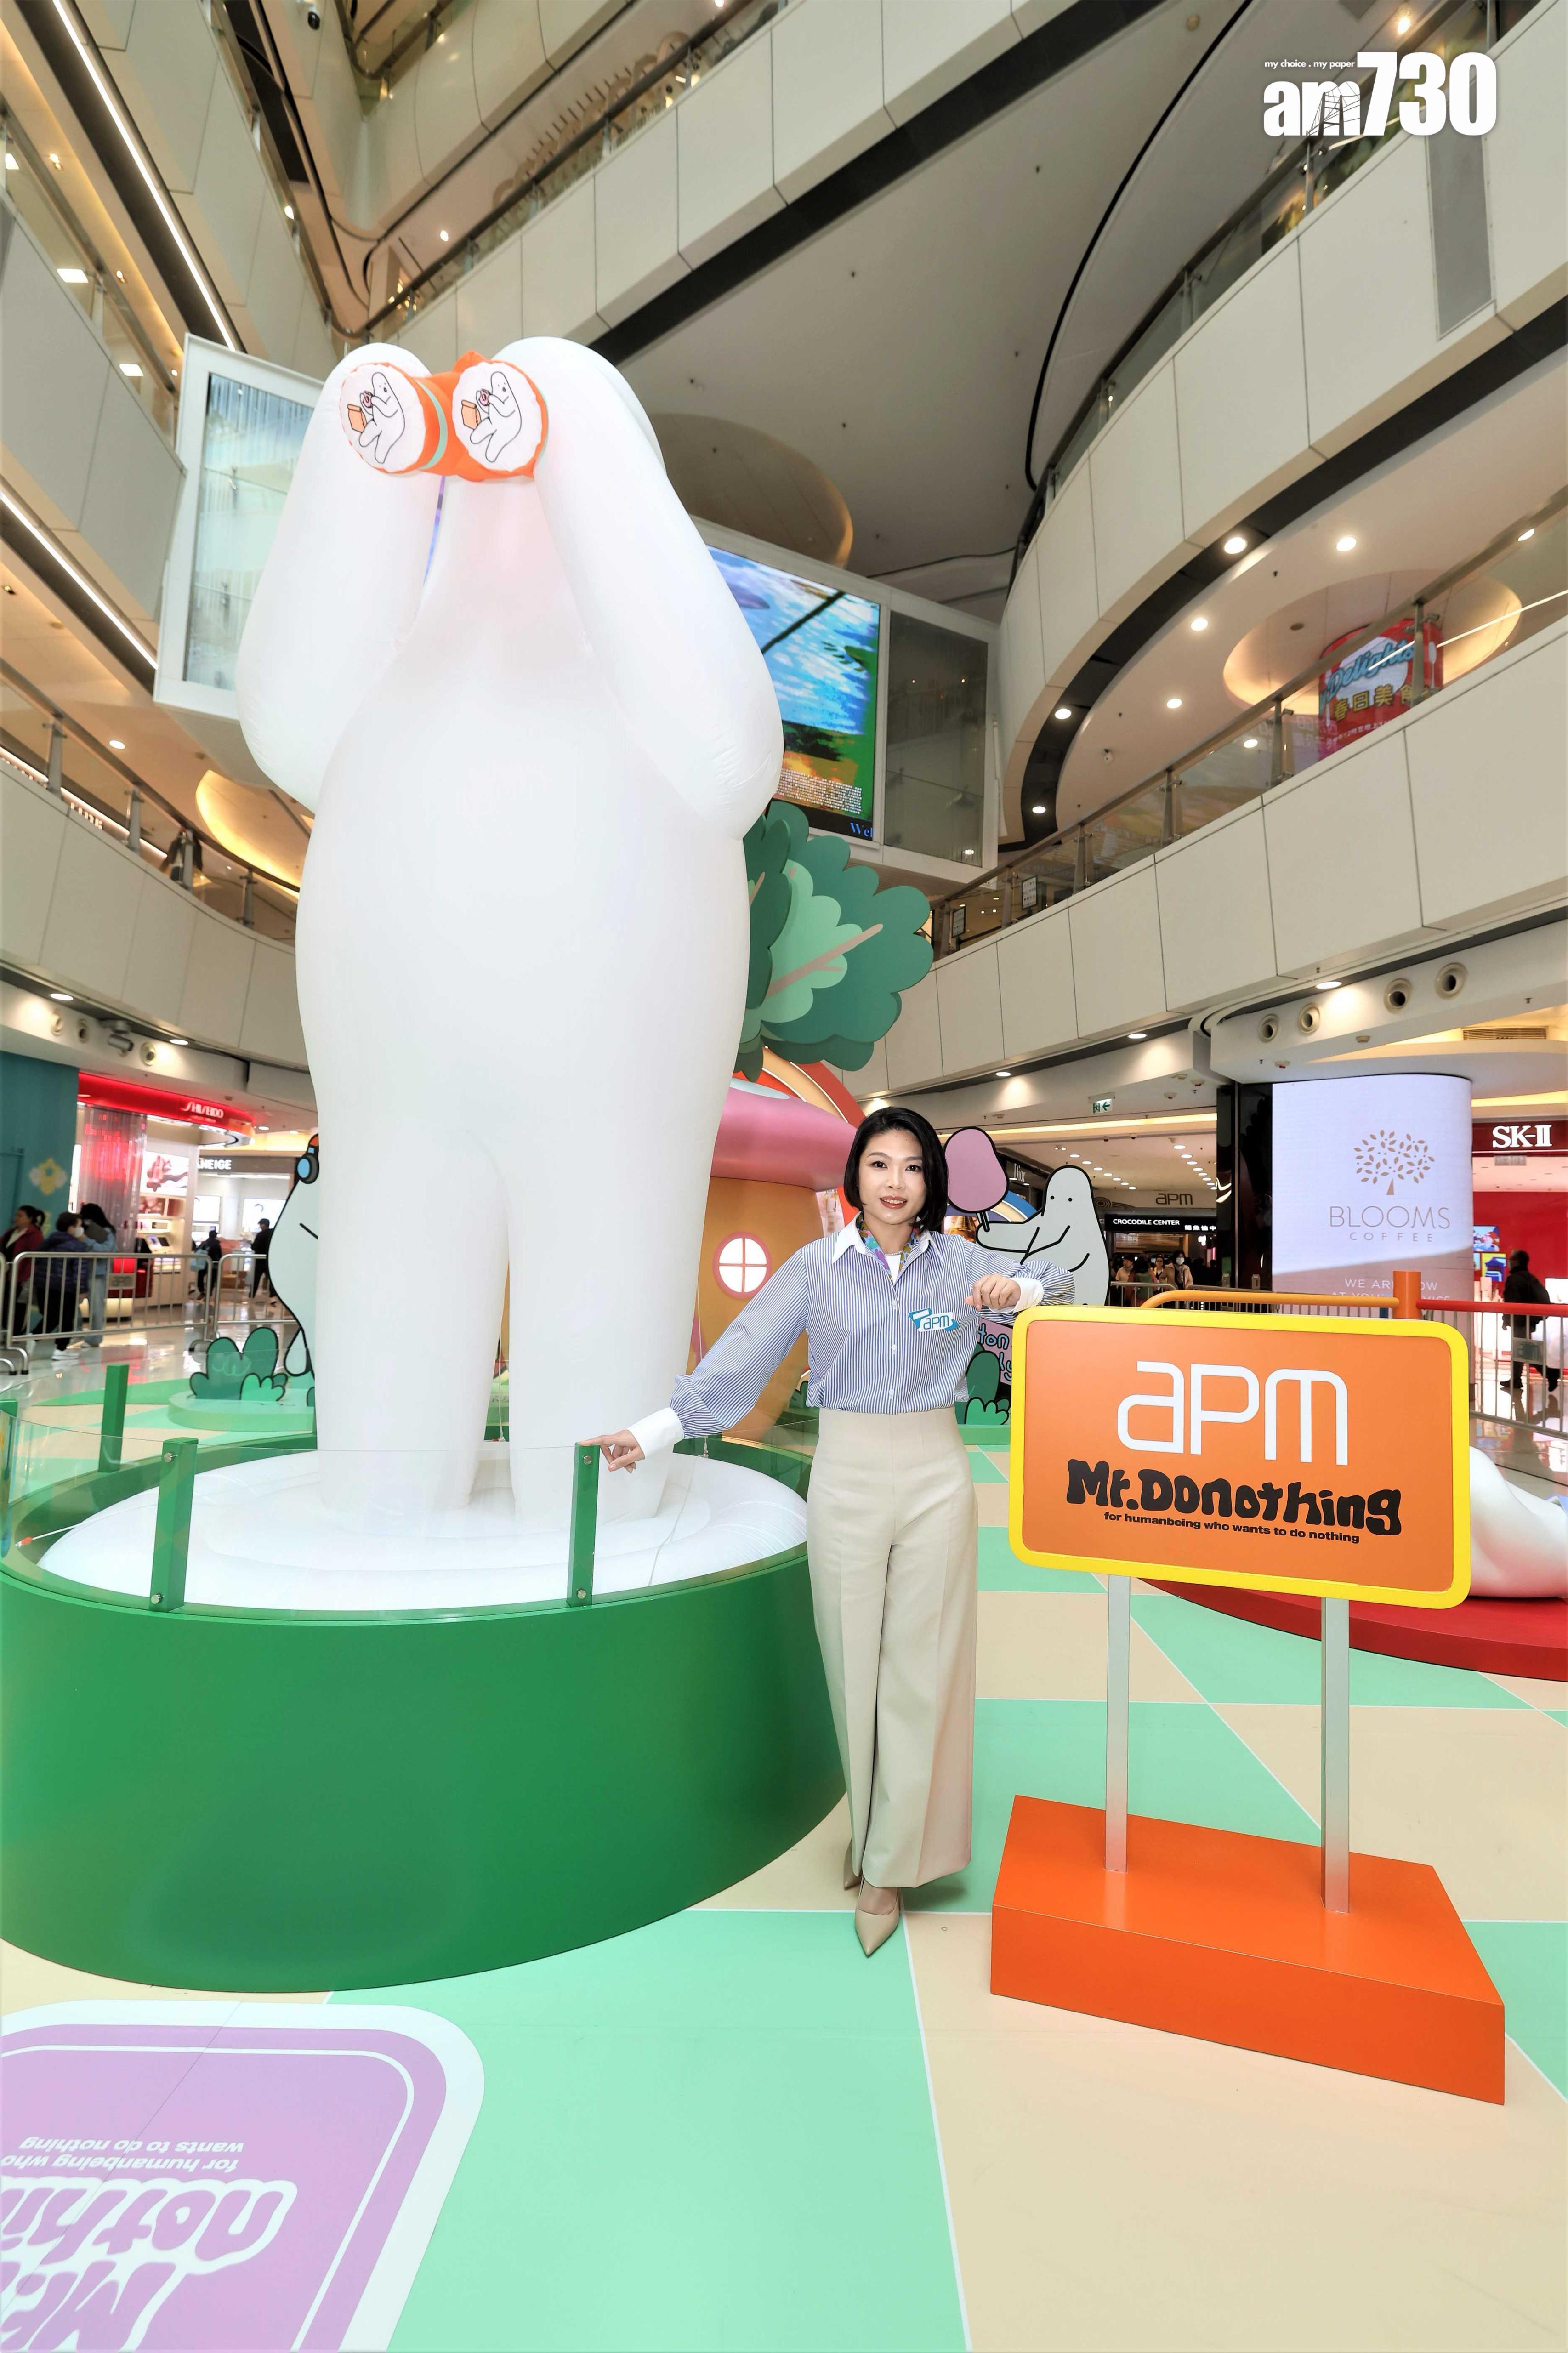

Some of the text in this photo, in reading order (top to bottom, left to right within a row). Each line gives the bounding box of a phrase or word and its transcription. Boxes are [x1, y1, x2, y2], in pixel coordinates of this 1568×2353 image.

[1333, 683, 1428, 721] 春日美食
[1492, 1125, 1553, 1148] SK-II
[1014, 1163, 1026, 1182] Dior
[1330, 1206, 1450, 1229] BLOOMS
[1350, 1232, 1433, 1242] COFFEE
[1345, 1279, 1365, 1288] WE
[1371, 1280, 1393, 1289] AR
[979, 1323, 1010, 1350] ton
[1104, 1512, 1359, 1544] for humanbeing who wants to do nothing
[19, 2136, 244, 2154] wants to do nothing
[0, 2154, 239, 2173] for humanbeing who
